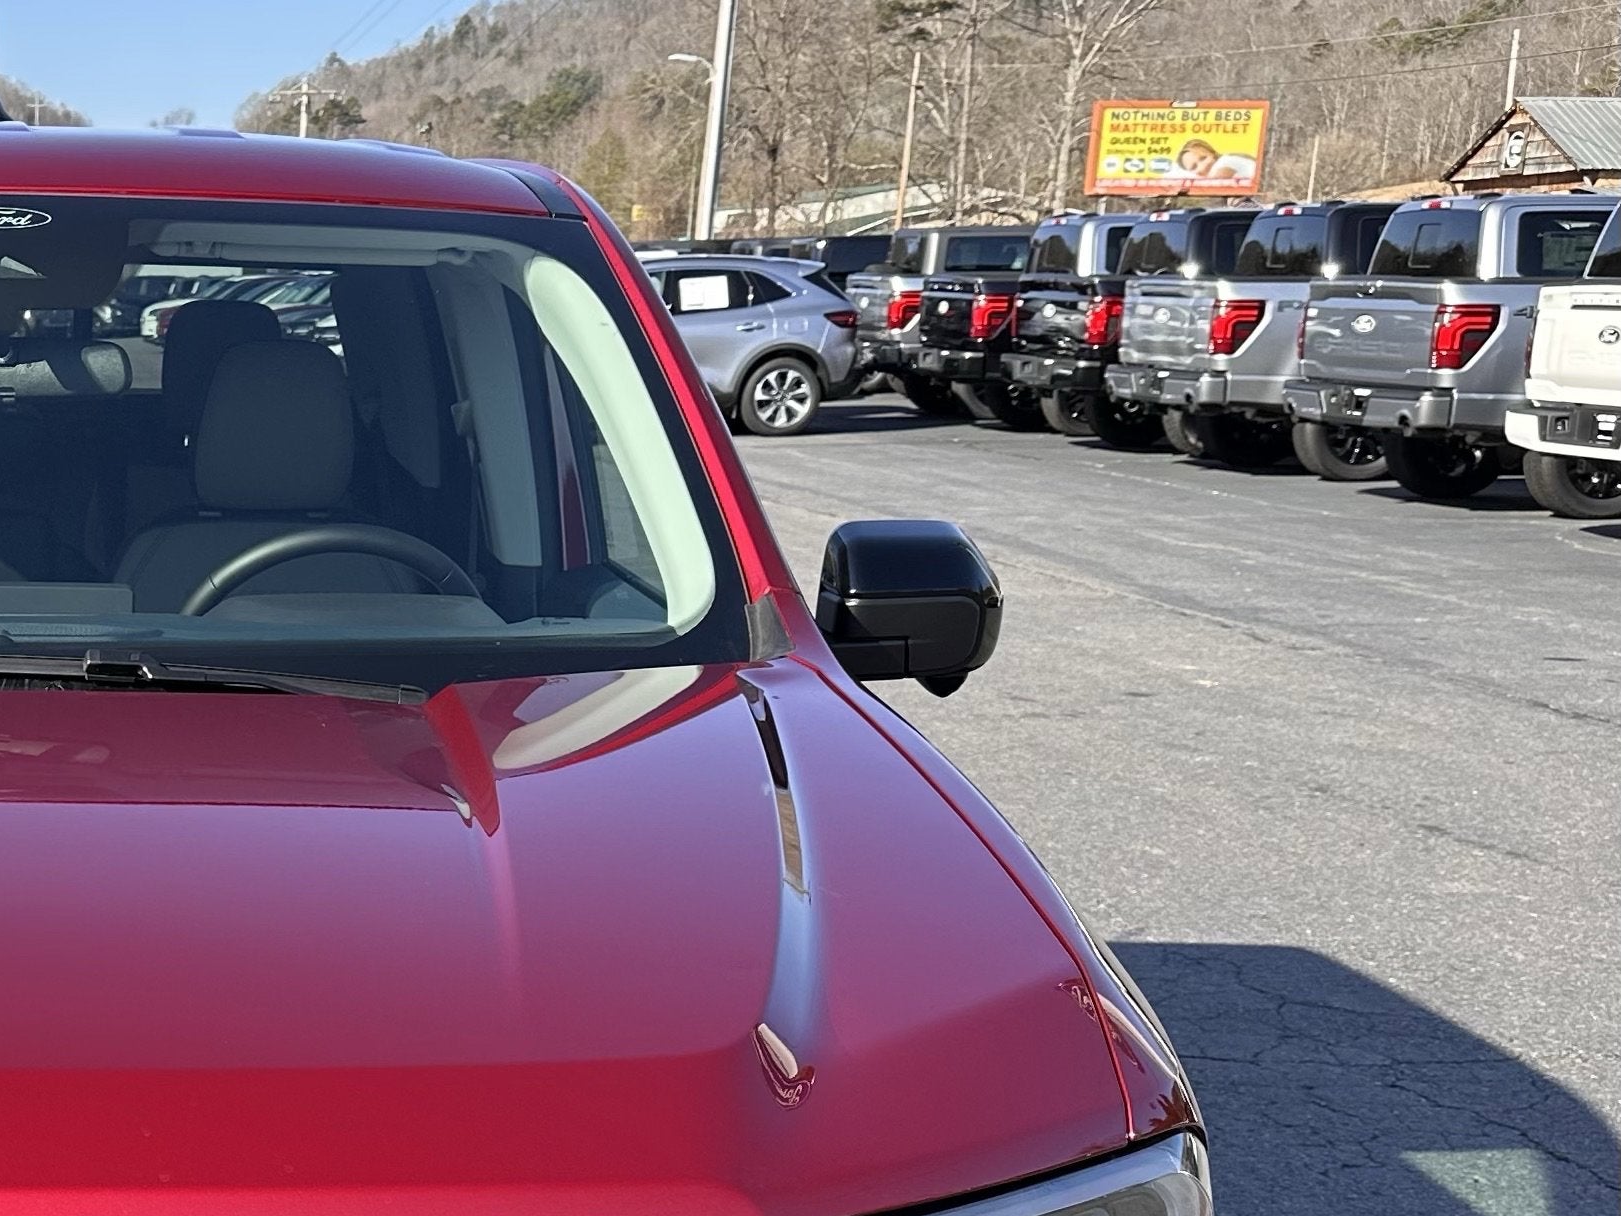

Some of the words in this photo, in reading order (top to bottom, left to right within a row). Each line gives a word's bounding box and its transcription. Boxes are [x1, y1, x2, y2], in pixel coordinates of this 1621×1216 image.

[1111, 110, 1176, 121] NOTHING
[1181, 110, 1209, 121] BUT
[1214, 110, 1252, 121] BEDS
[1109, 123, 1186, 133] MATTRESS
[1192, 123, 1249, 133] OUTLET
[1110, 136, 1146, 145] QUEEN
